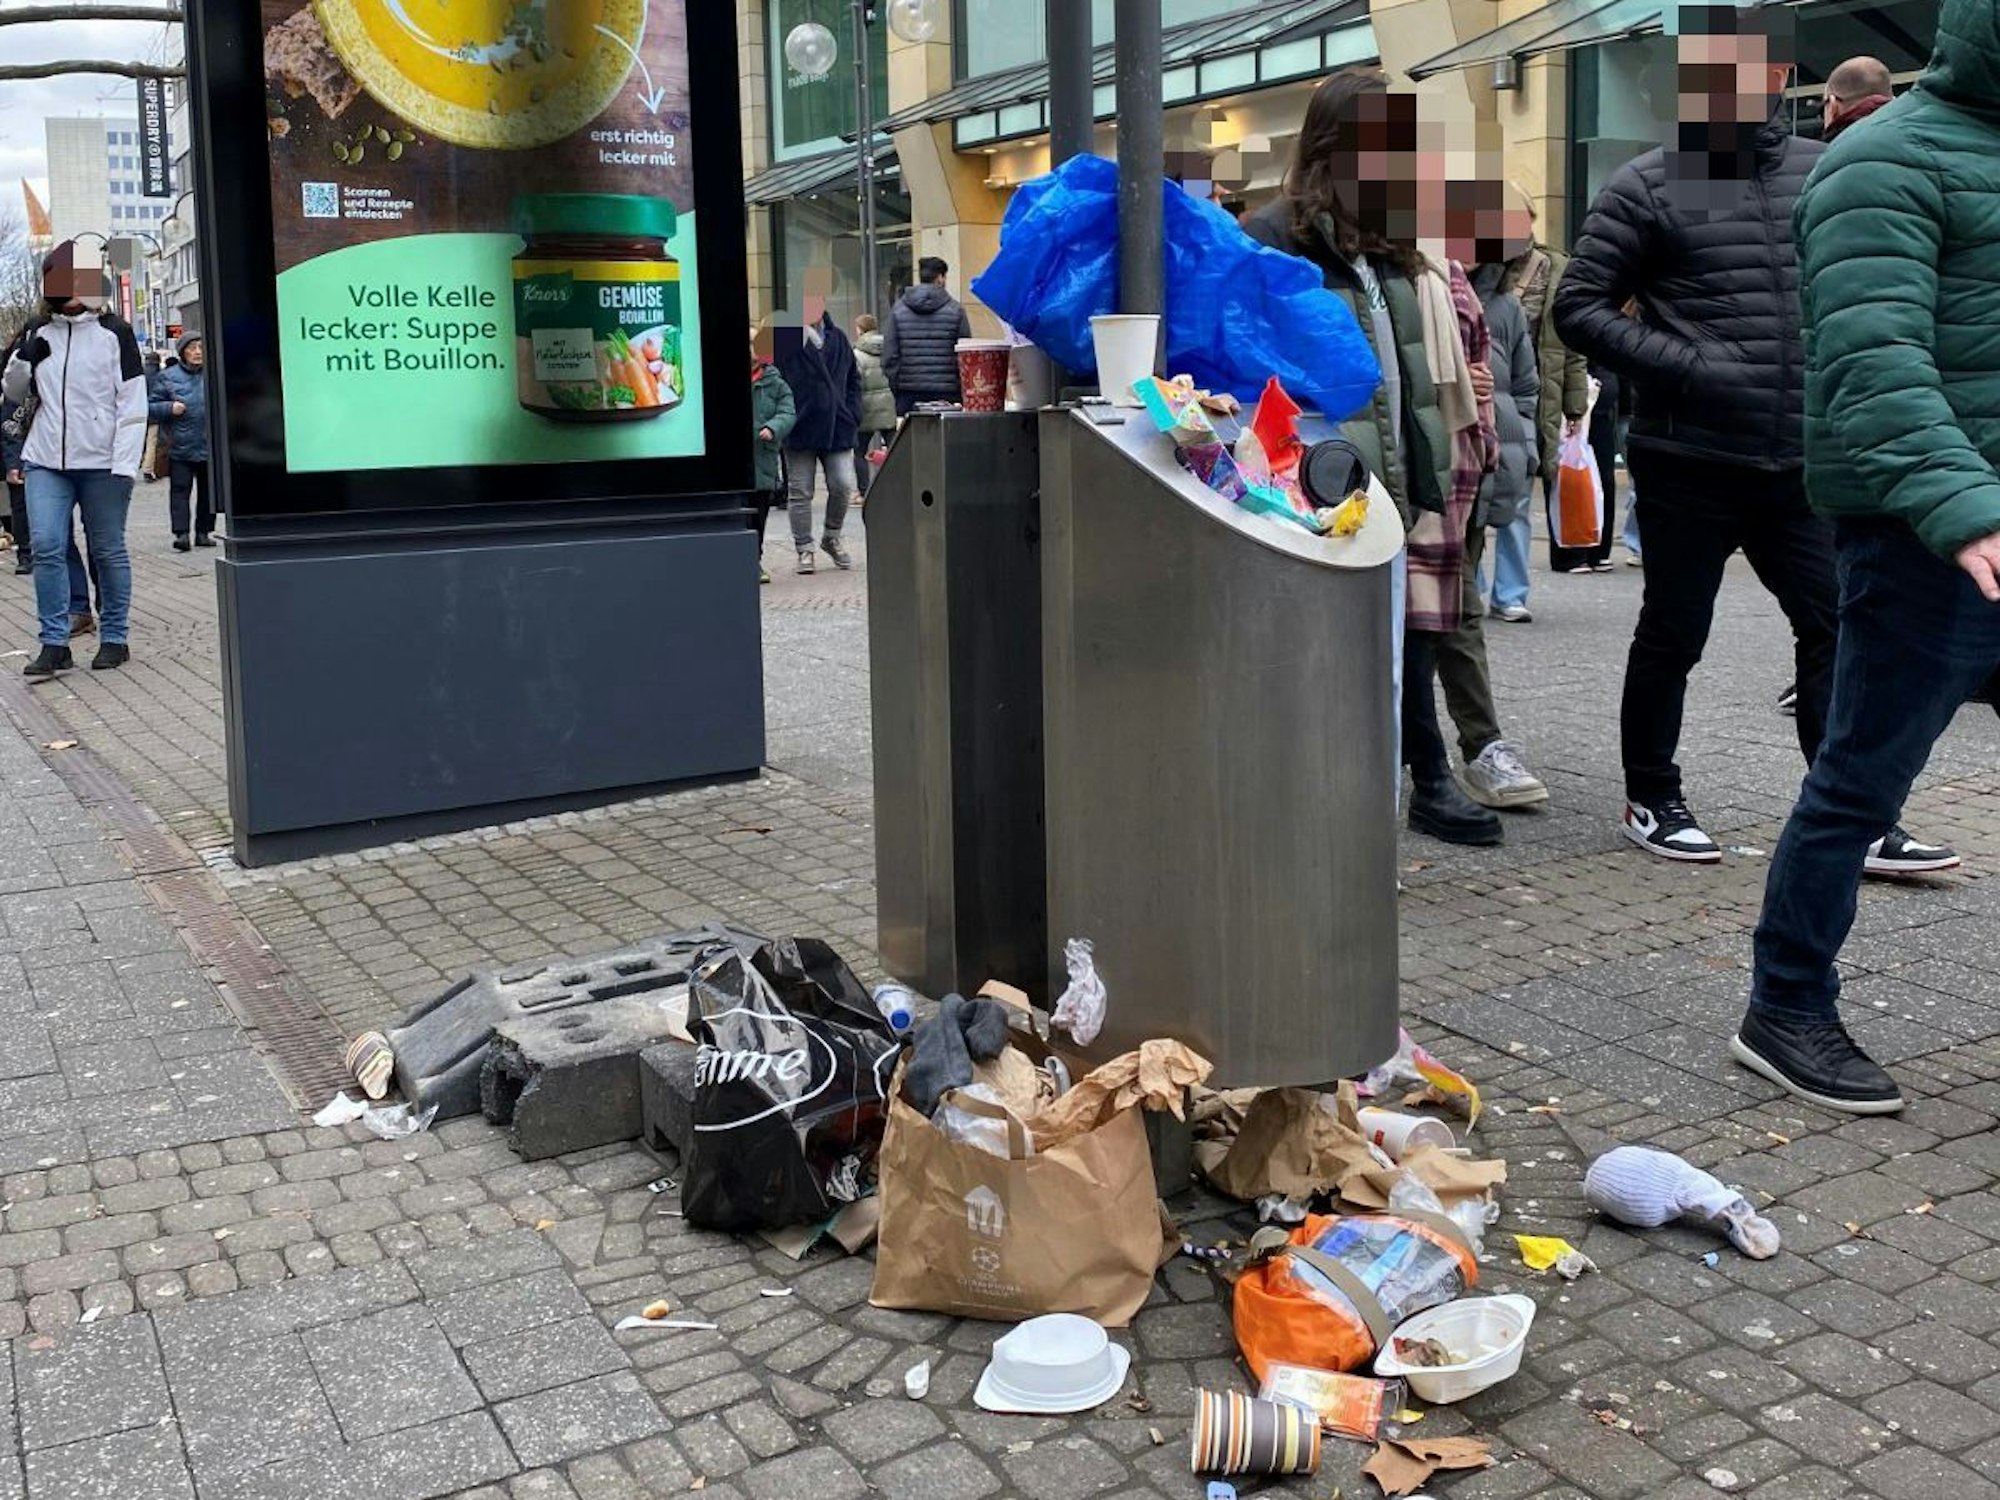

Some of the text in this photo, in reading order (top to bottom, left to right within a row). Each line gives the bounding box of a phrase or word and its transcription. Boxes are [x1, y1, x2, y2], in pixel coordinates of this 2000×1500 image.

[590, 129, 675, 149] erst richtig
[599, 149, 676, 166] lecker mit
[343, 186, 391, 197] Scannen
[343, 198, 414, 210] und Rezepte
[343, 209, 403, 220] entdecken
[348, 284, 496, 308] Volle Kelle
[523, 284, 567, 302] Knorr
[599, 282, 664, 308] GEMÜSE
[618, 309, 665, 325] BOUILLON
[300, 316, 497, 345] lecker: Suppe
[326, 347, 505, 372] mit Bouillon.
